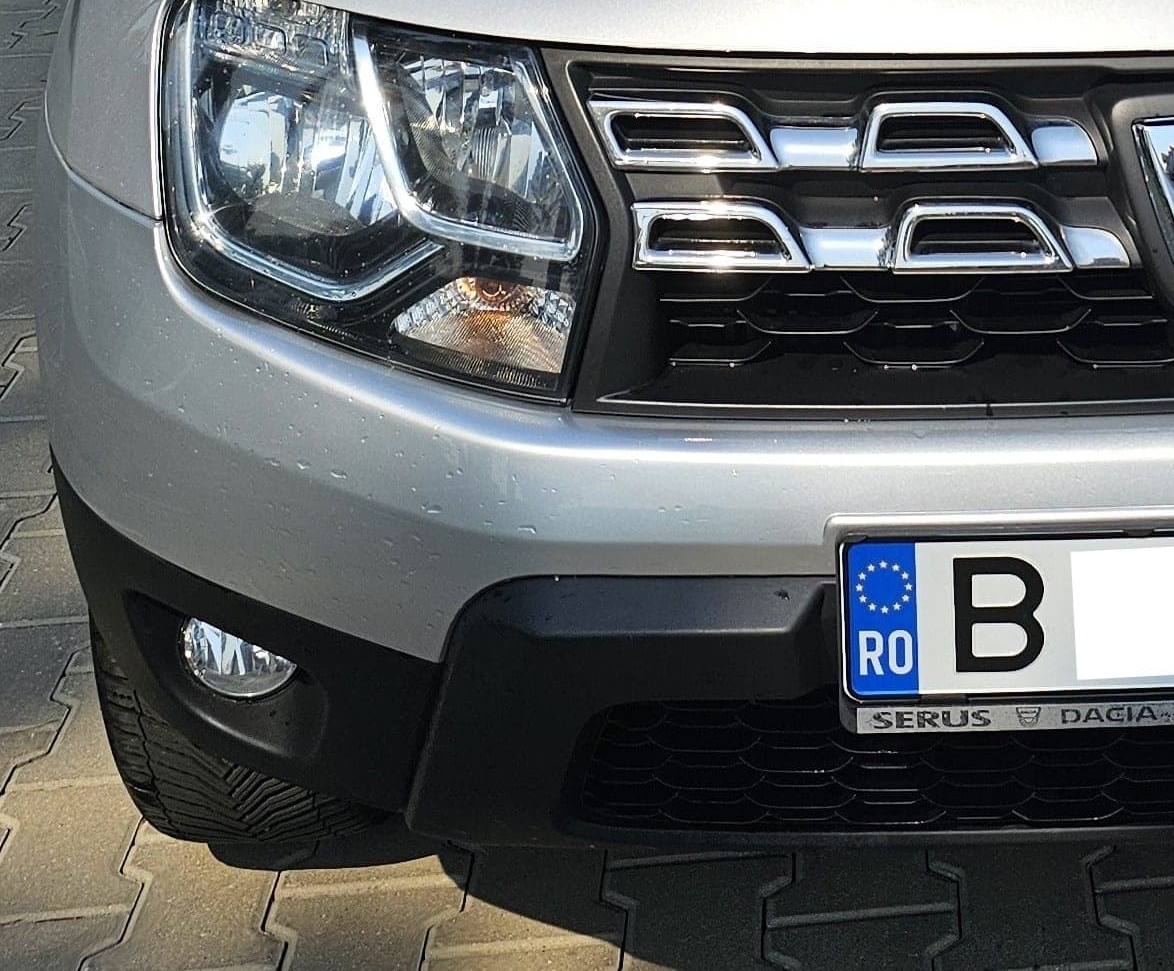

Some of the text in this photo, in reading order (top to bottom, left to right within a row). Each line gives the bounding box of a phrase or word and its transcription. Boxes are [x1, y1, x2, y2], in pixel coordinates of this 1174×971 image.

[953, 556, 1046, 673] B
[858, 629, 914, 677] RO
[872, 708, 992, 730] SERUS
[1060, 705, 1158, 724] DACIA
